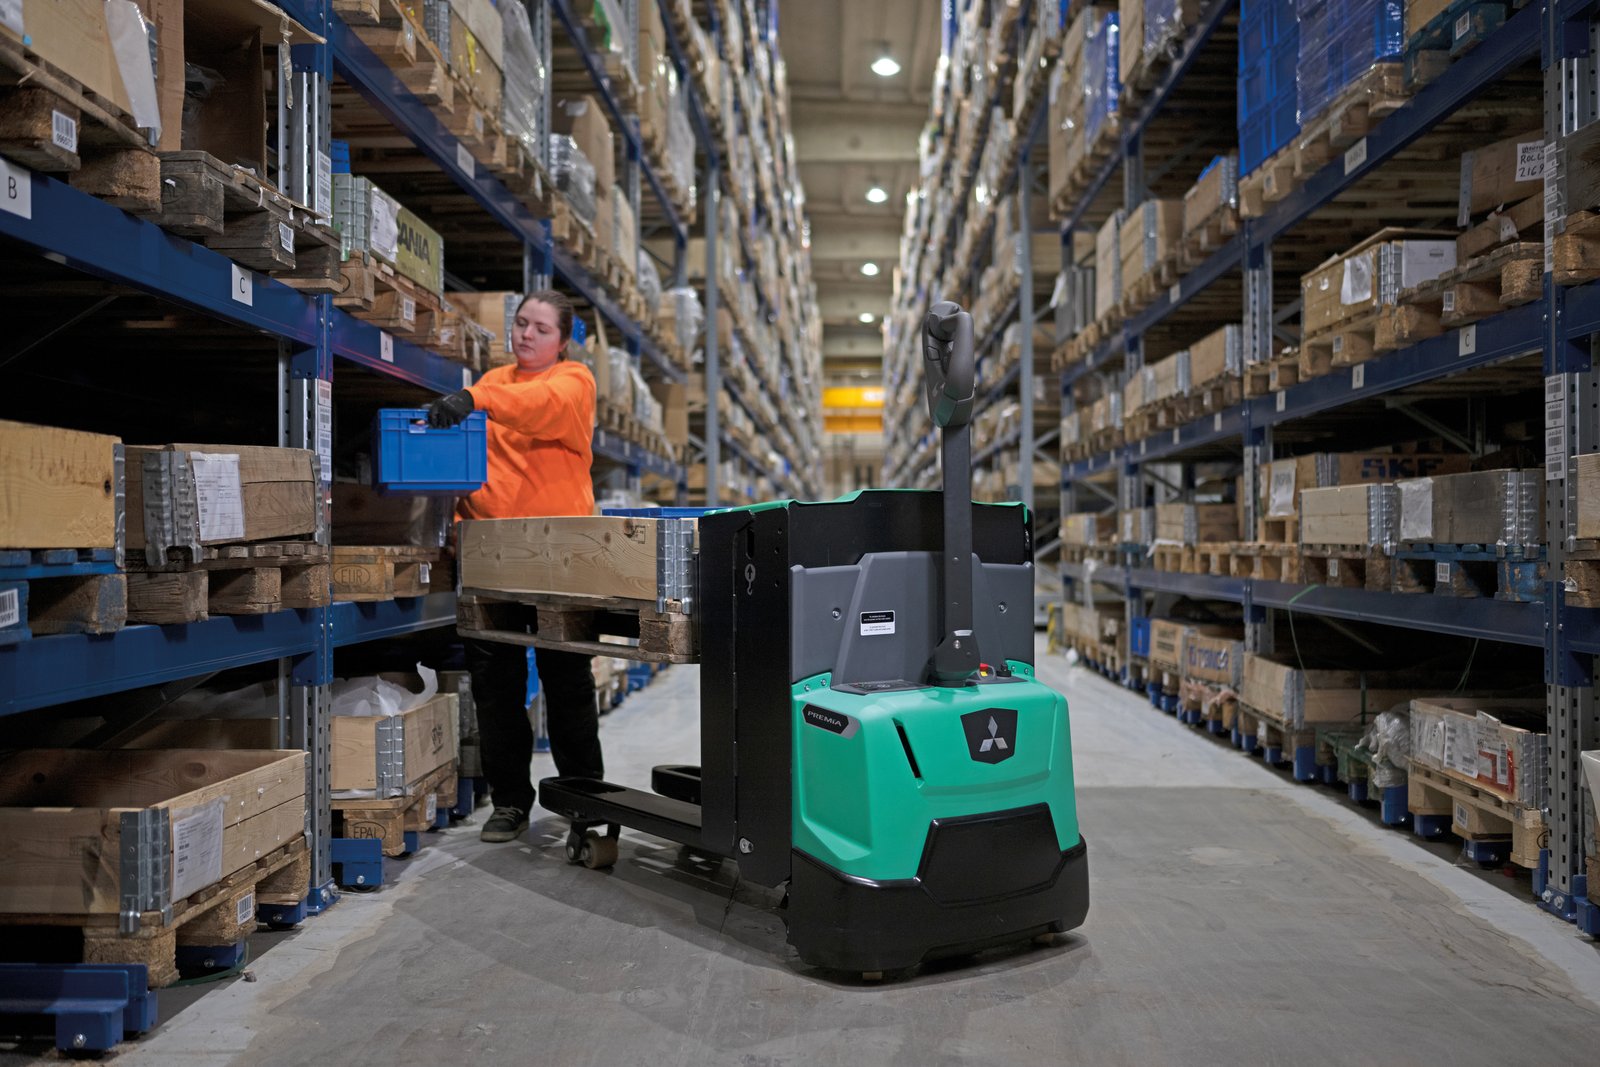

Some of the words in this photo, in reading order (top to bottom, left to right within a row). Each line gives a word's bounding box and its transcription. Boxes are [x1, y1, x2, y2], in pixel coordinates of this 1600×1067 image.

[8, 175, 17, 199] B
[397, 216, 431, 266] ANIA
[240, 276, 246, 294] C
[1464, 333, 1470, 347] C
[341, 568, 364, 585] EUR
